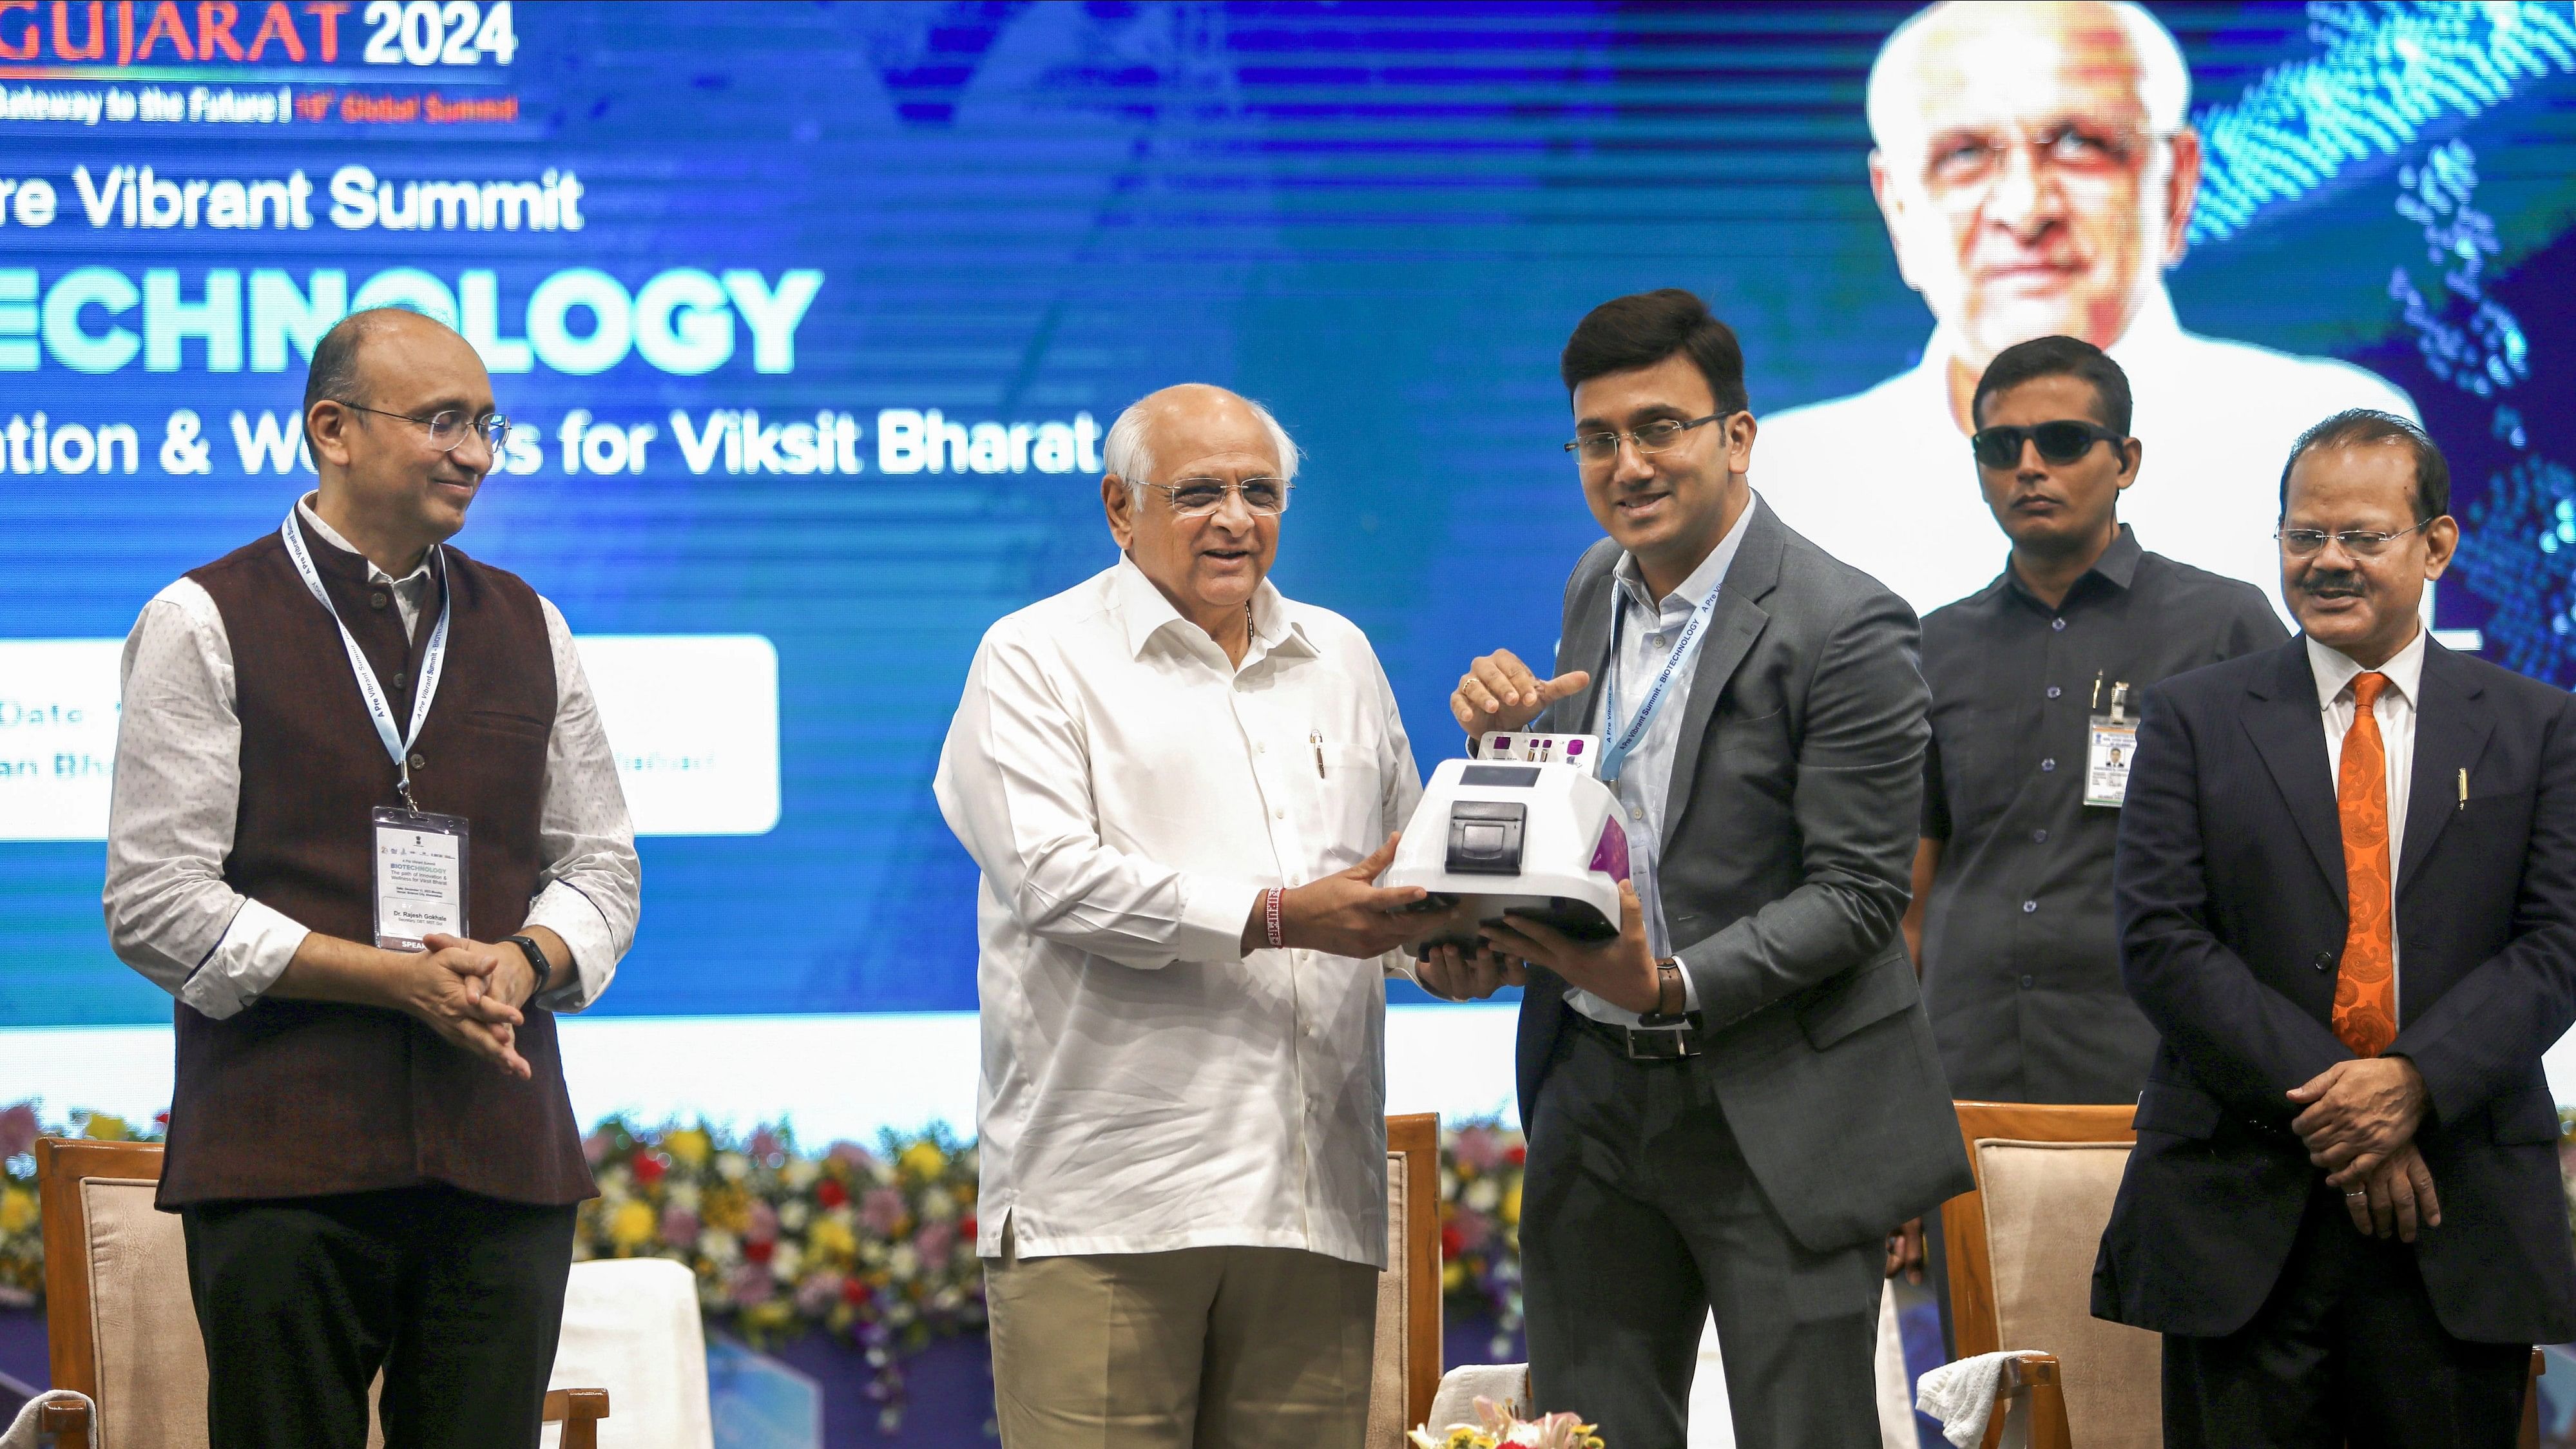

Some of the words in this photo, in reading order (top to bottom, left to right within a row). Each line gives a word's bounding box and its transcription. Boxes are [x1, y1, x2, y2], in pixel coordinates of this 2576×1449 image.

[0, 1, 351, 66] GUJARAT
[364, 1, 517, 65] 2024
[0, 84, 102, 125] ateway
[104, 86, 137, 121] to
[140, 86, 185, 122] the
[188, 86, 277, 123] Future
[73, 164, 313, 228] Vibrant
[329, 166, 584, 231] Summit
[0, 410, 138, 475] tion
[159, 409, 213, 475] &
[557, 408, 657, 475] for
[669, 408, 864, 475] Viksit
[877, 408, 1103, 475] Bharat
[289, 533, 302, 558] Vibrant
[300, 557, 309, 570] Pre
[1705, 594, 1716, 607] Pre
[363, 671, 376, 698] Vibrant
[421, 675, 433, 698] Vibrant
[427, 653, 437, 675] Summit
[1629, 714, 1646, 740] Vibrant
[1642, 687, 1662, 716] Summit
[1659, 619, 1700, 683] BIOTECHNOLOGY
[374, 698, 382, 711] Pre
[390, 863, 446, 874] BIOTECHNOLOGY
